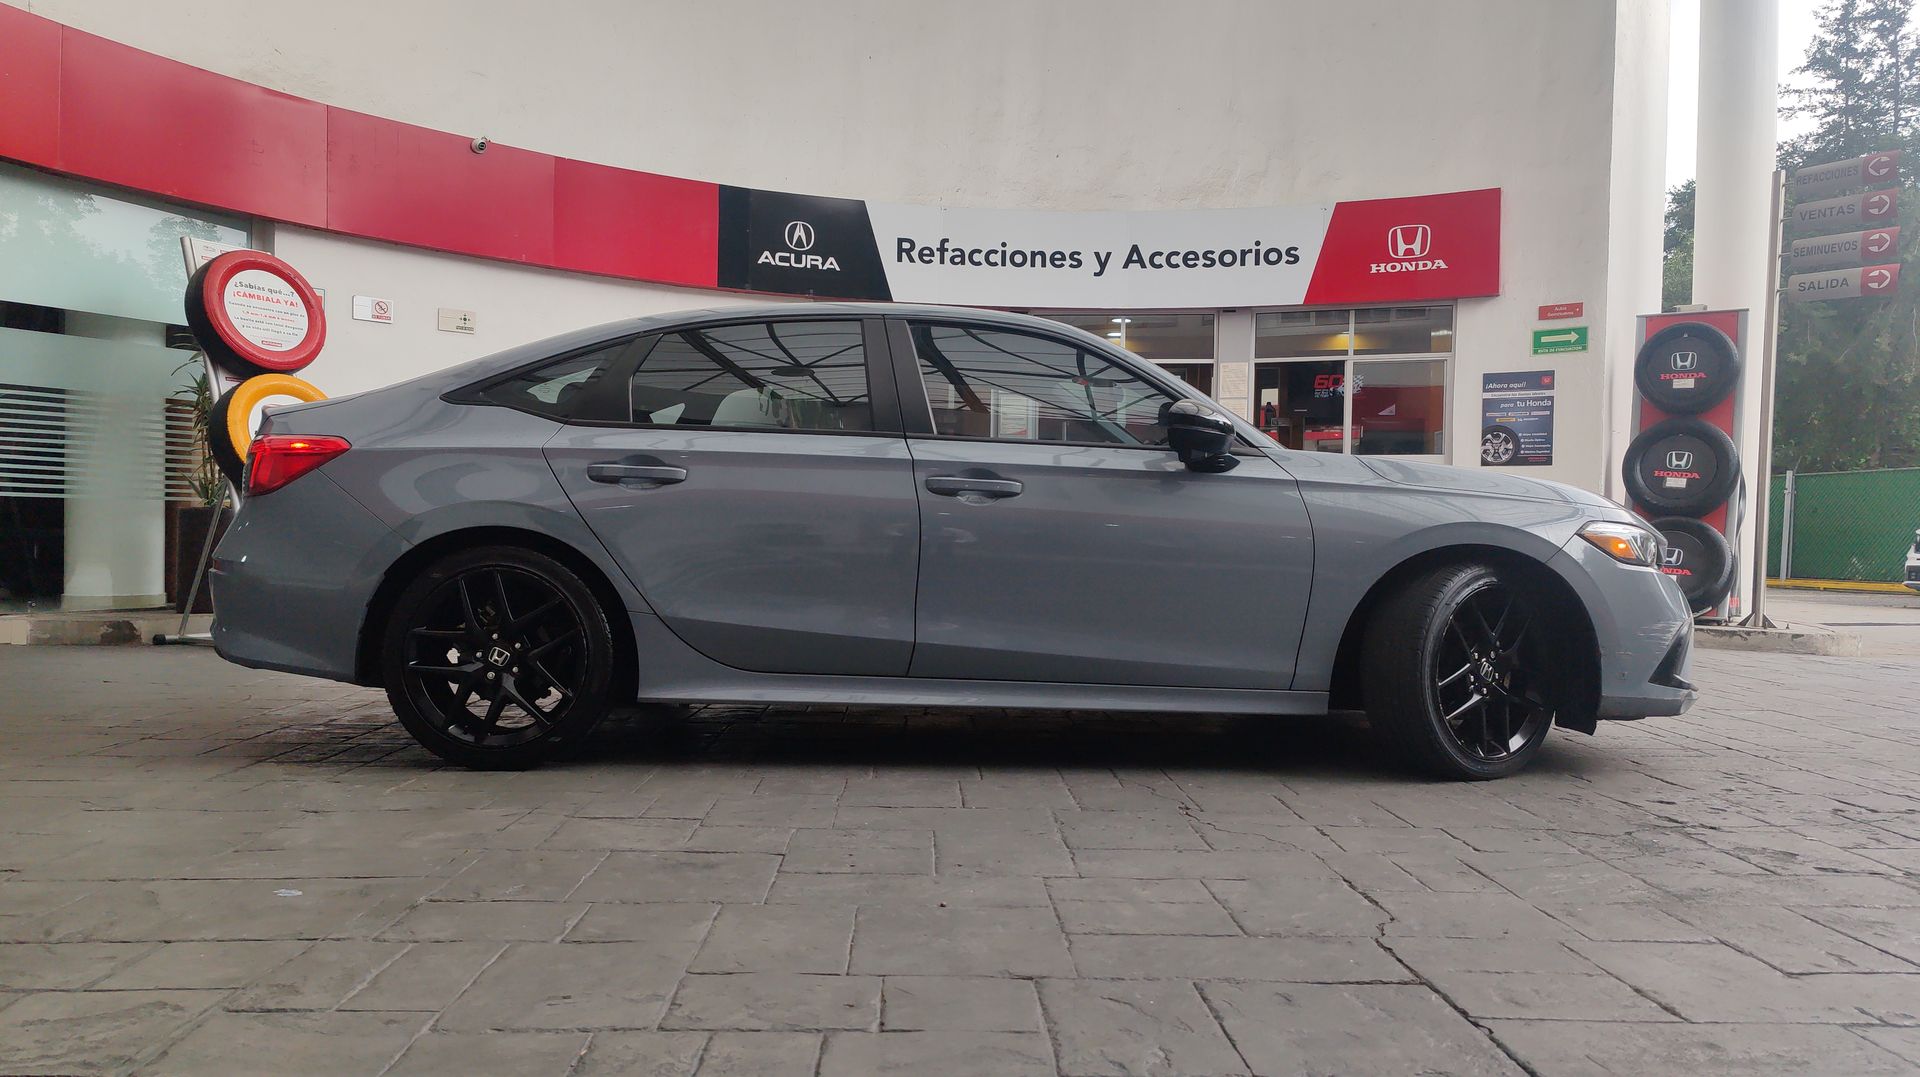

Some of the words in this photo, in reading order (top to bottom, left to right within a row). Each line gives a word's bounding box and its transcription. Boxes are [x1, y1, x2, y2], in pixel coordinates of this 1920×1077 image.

[1796, 165, 1859, 186] REFACCIONES
[1799, 204, 1856, 222] VENTAS
[896, 236, 1082, 268] Refacciones
[1094, 248, 1112, 277] y
[1122, 240, 1300, 270] Accesorios
[1793, 240, 1858, 258] SEMINUEVOS
[758, 250, 840, 271] ACURA
[1370, 259, 1448, 274] HONDA
[1798, 277, 1850, 292] SALIDA
[283, 299, 298, 308] YA!
[1660, 372, 1707, 380] HONDA
[1653, 470, 1701, 479] HONDA
